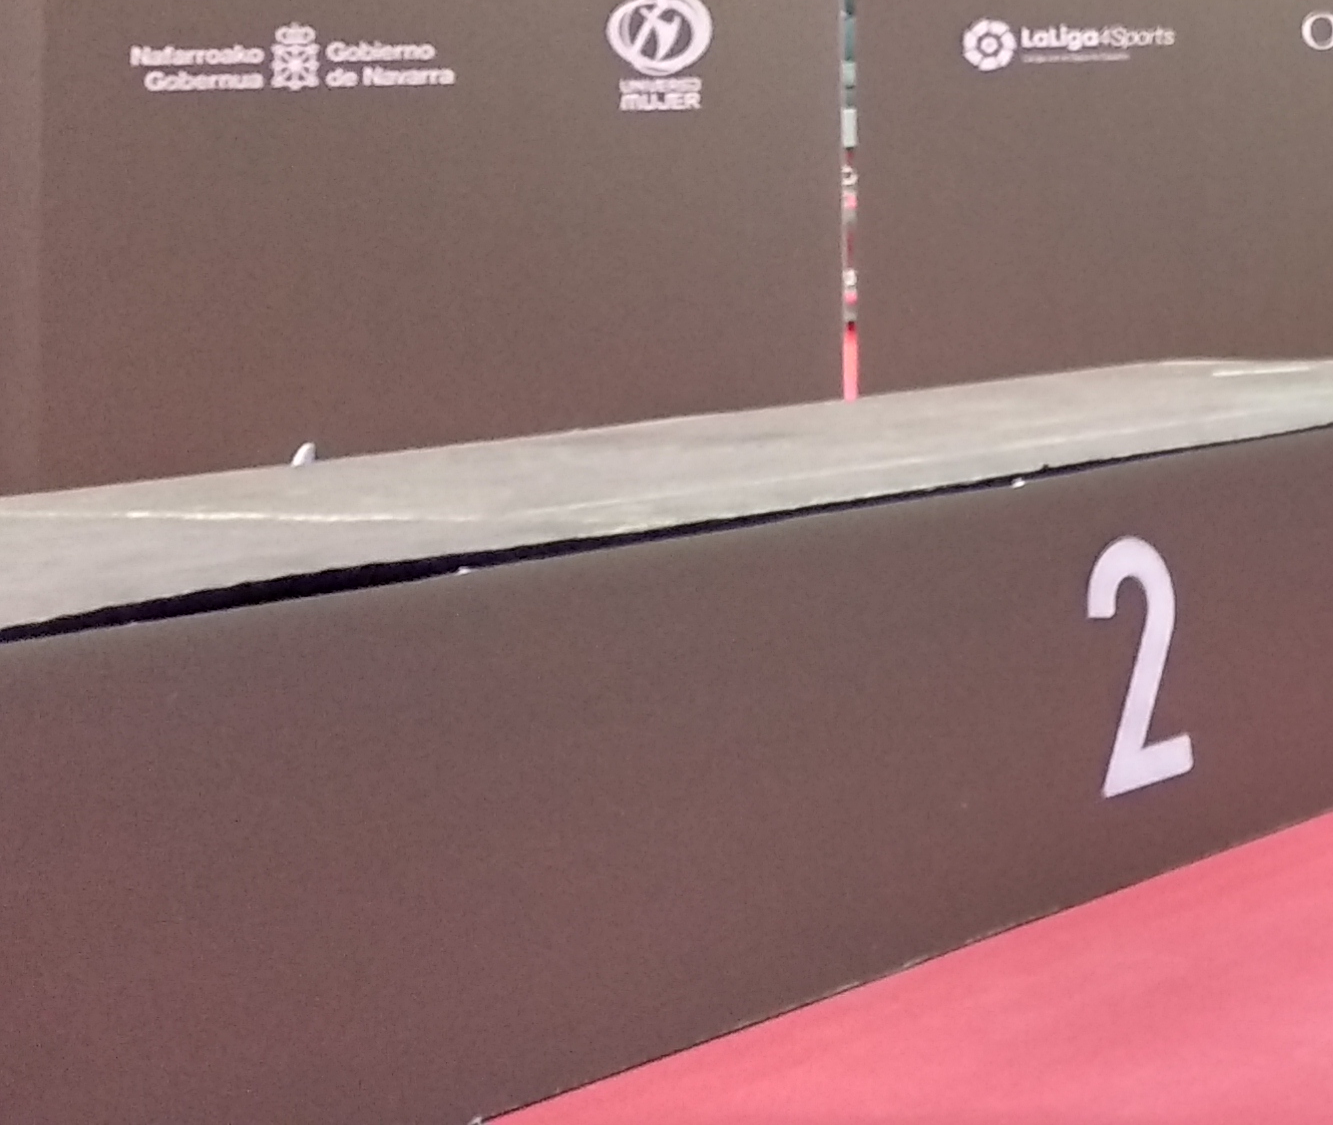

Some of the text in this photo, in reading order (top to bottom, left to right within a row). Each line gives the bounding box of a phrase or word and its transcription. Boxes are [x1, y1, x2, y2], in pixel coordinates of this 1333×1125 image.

[129, 44, 266, 66] Nafarroako
[325, 40, 437, 63] Gobierno
[144, 70, 264, 91] Gobernua
[325, 66, 456, 88] de Navarra
[619, 92, 702, 111] MUJER
[1087, 535, 1195, 799] 2
